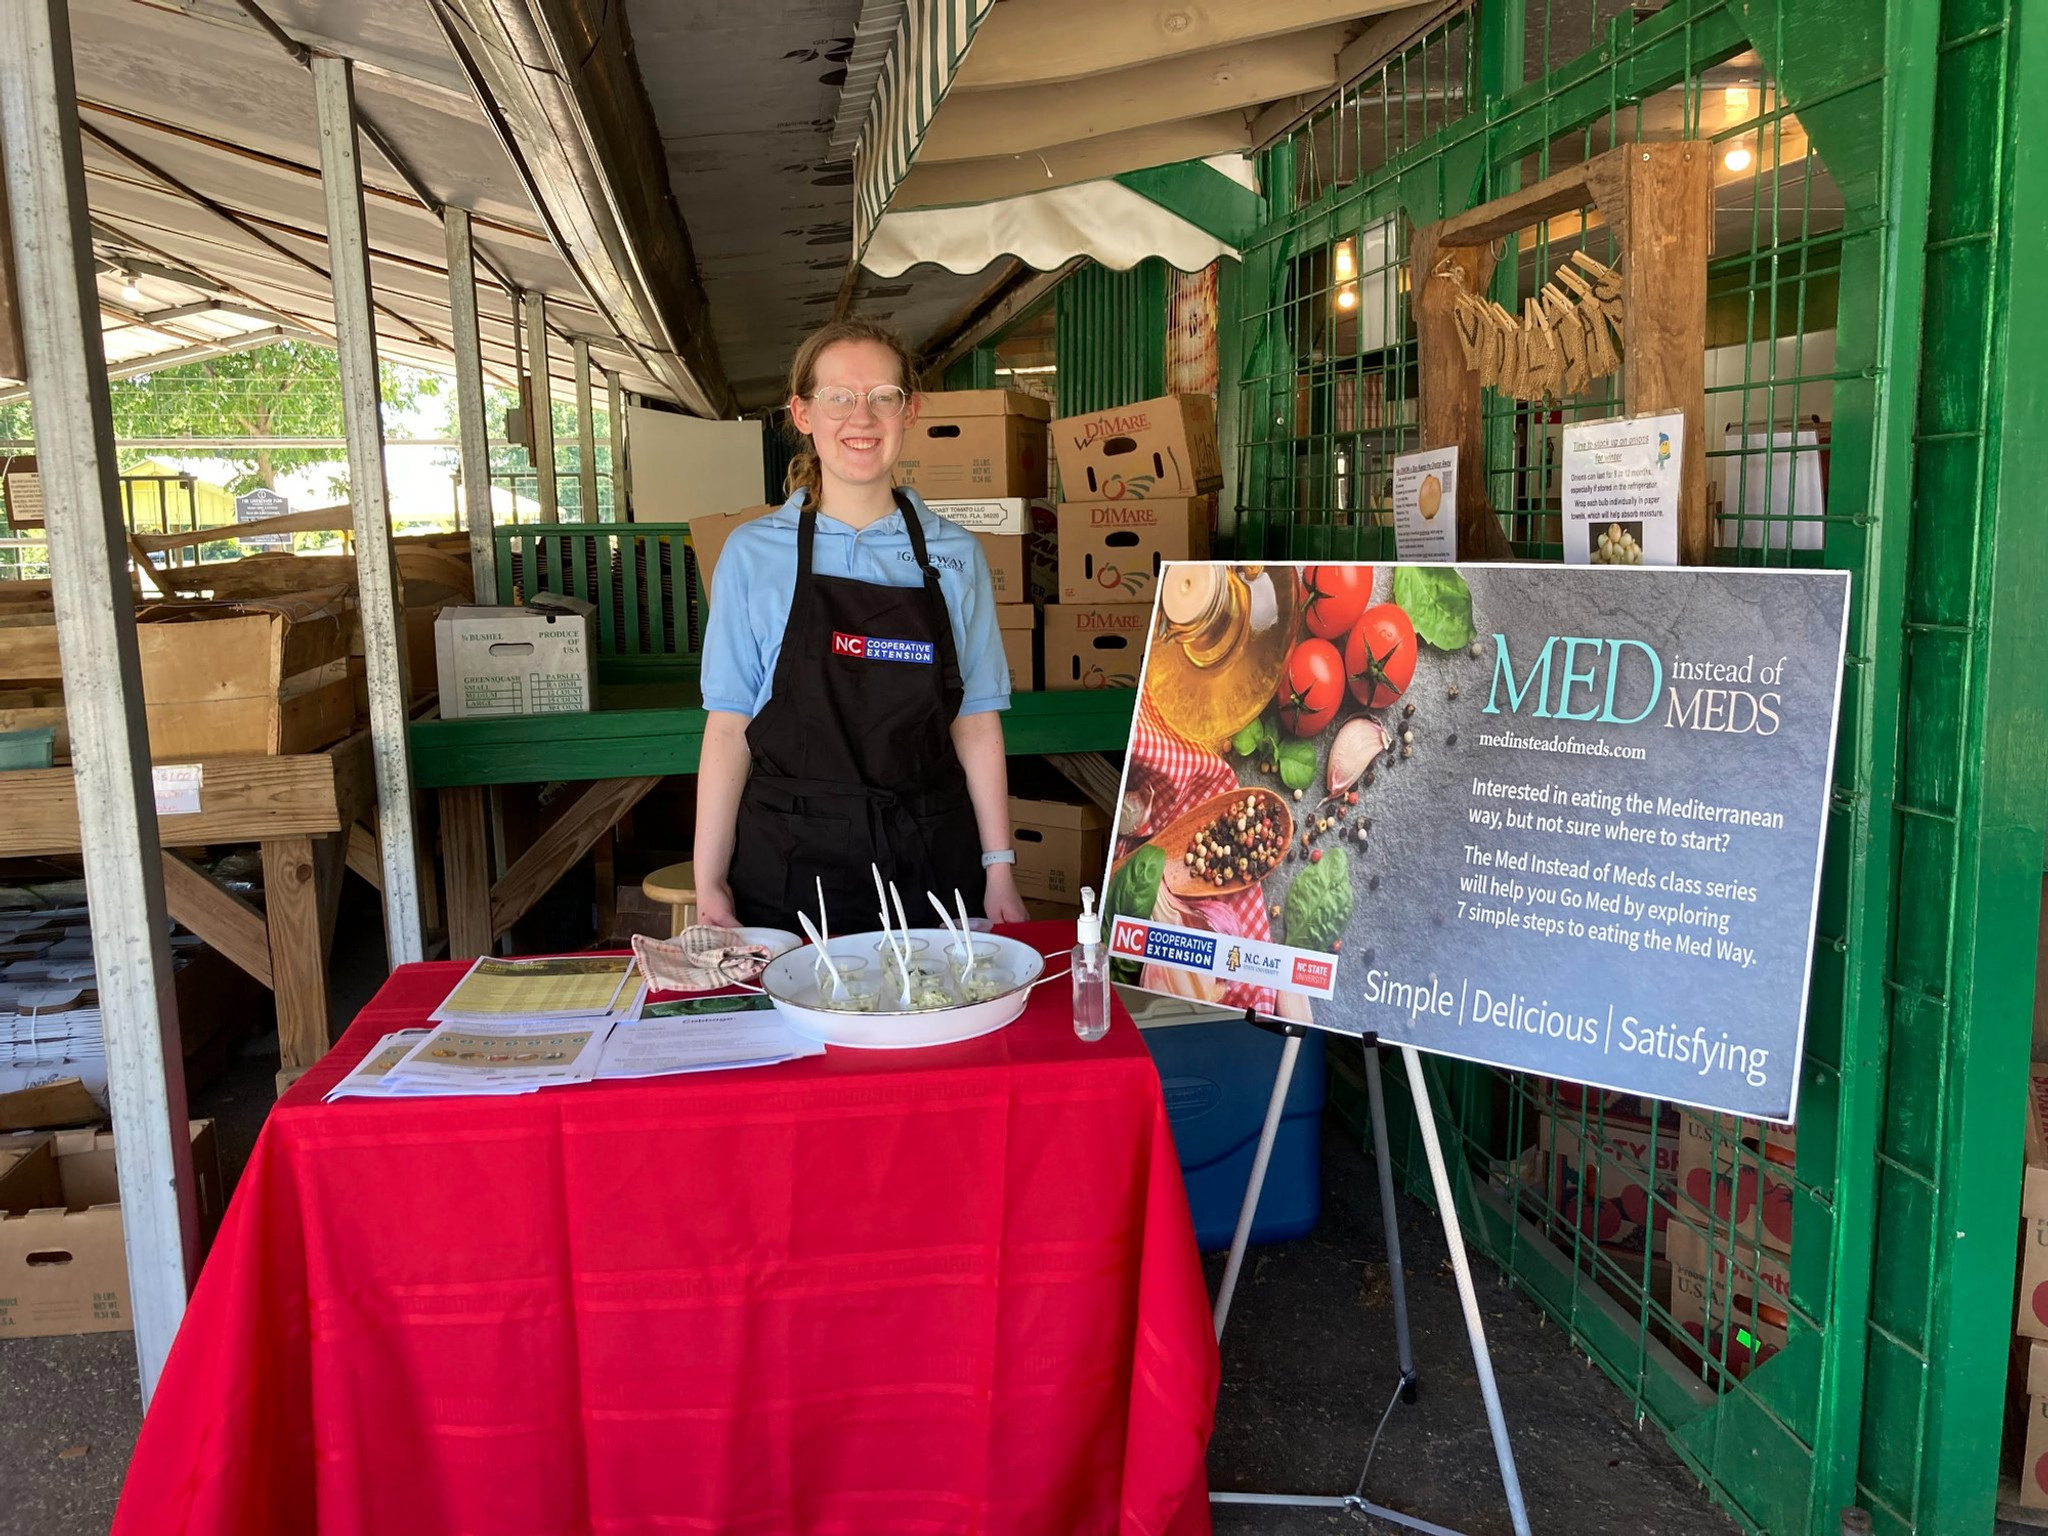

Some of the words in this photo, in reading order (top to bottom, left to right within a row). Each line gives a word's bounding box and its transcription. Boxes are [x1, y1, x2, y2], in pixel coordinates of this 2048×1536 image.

[1597, 471, 1605, 479] last
[1575, 500, 1586, 508] Wrap
[1587, 499, 1597, 507] each
[1599, 498, 1608, 506] bulb
[1644, 496, 1660, 505] paper
[1588, 511, 1600, 519] which
[1610, 510, 1620, 519] help
[1622, 509, 1638, 518] absorb
[902, 552, 966, 569] GEWAY
[836, 636, 862, 654] NC
[867, 640, 931, 652] COOPERATIVE
[867, 649, 930, 661] EXTENSION
[1482, 633, 1663, 724] MED
[1672, 655, 1753, 684] instead
[1760, 657, 1787, 685] of
[1664, 687, 1781, 736] MEDS
[1479, 731, 1646, 760] medinsteadofmeds.com
[1472, 778, 1549, 803] Interested
[1553, 785, 1567, 805] in
[1571, 790, 1622, 816] eating
[1626, 794, 1653, 814] the
[1657, 797, 1784, 829] Mediterranean
[1469, 808, 1502, 830] way,
[1506, 809, 1533, 829] but
[1536, 815, 1563, 833] not
[1566, 819, 1601, 837] sure
[1604, 821, 1656, 844] where
[1660, 829, 1677, 846] to
[1681, 833, 1730, 853] start?
[1464, 846, 1492, 866] The
[1495, 850, 1528, 872] Med
[1531, 854, 1589, 880] Instead
[1593, 863, 1611, 882] of
[1613, 865, 1656, 889] Meds
[1660, 871, 1702, 895] class
[1705, 879, 1757, 902] series
[1460, 875, 1487, 894] will
[1490, 877, 1524, 903] help
[1527, 887, 1556, 906] you
[1560, 888, 1582, 908] Go
[1585, 891, 1619, 915] Med
[1624, 895, 1645, 921] by
[1648, 901, 1730, 935] exploring
[1116, 925, 1144, 951] NC
[1149, 930, 1213, 953] COOPERATIVE
[1457, 902, 1466, 919] 7
[1469, 903, 1520, 929] simple
[1522, 912, 1564, 936] steps
[1568, 918, 1584, 937] to
[1588, 923, 1640, 951] eating
[1644, 928, 1671, 951] the
[1675, 933, 1712, 958] Med
[1716, 940, 1757, 968] Way.
[1147, 943, 1211, 966] EXTENSION
[1244, 953, 1260, 965] N.C.
[1263, 957, 1281, 969] A&T
[1296, 972, 1327, 985] UNIVERSITY
[1297, 962, 1307, 972] NC
[1308, 964, 1328, 976] STATE
[1363, 969, 1453, 1019] Simple
[1472, 988, 1599, 1044] Delicious
[1618, 1016, 1770, 1087] Satisfying
